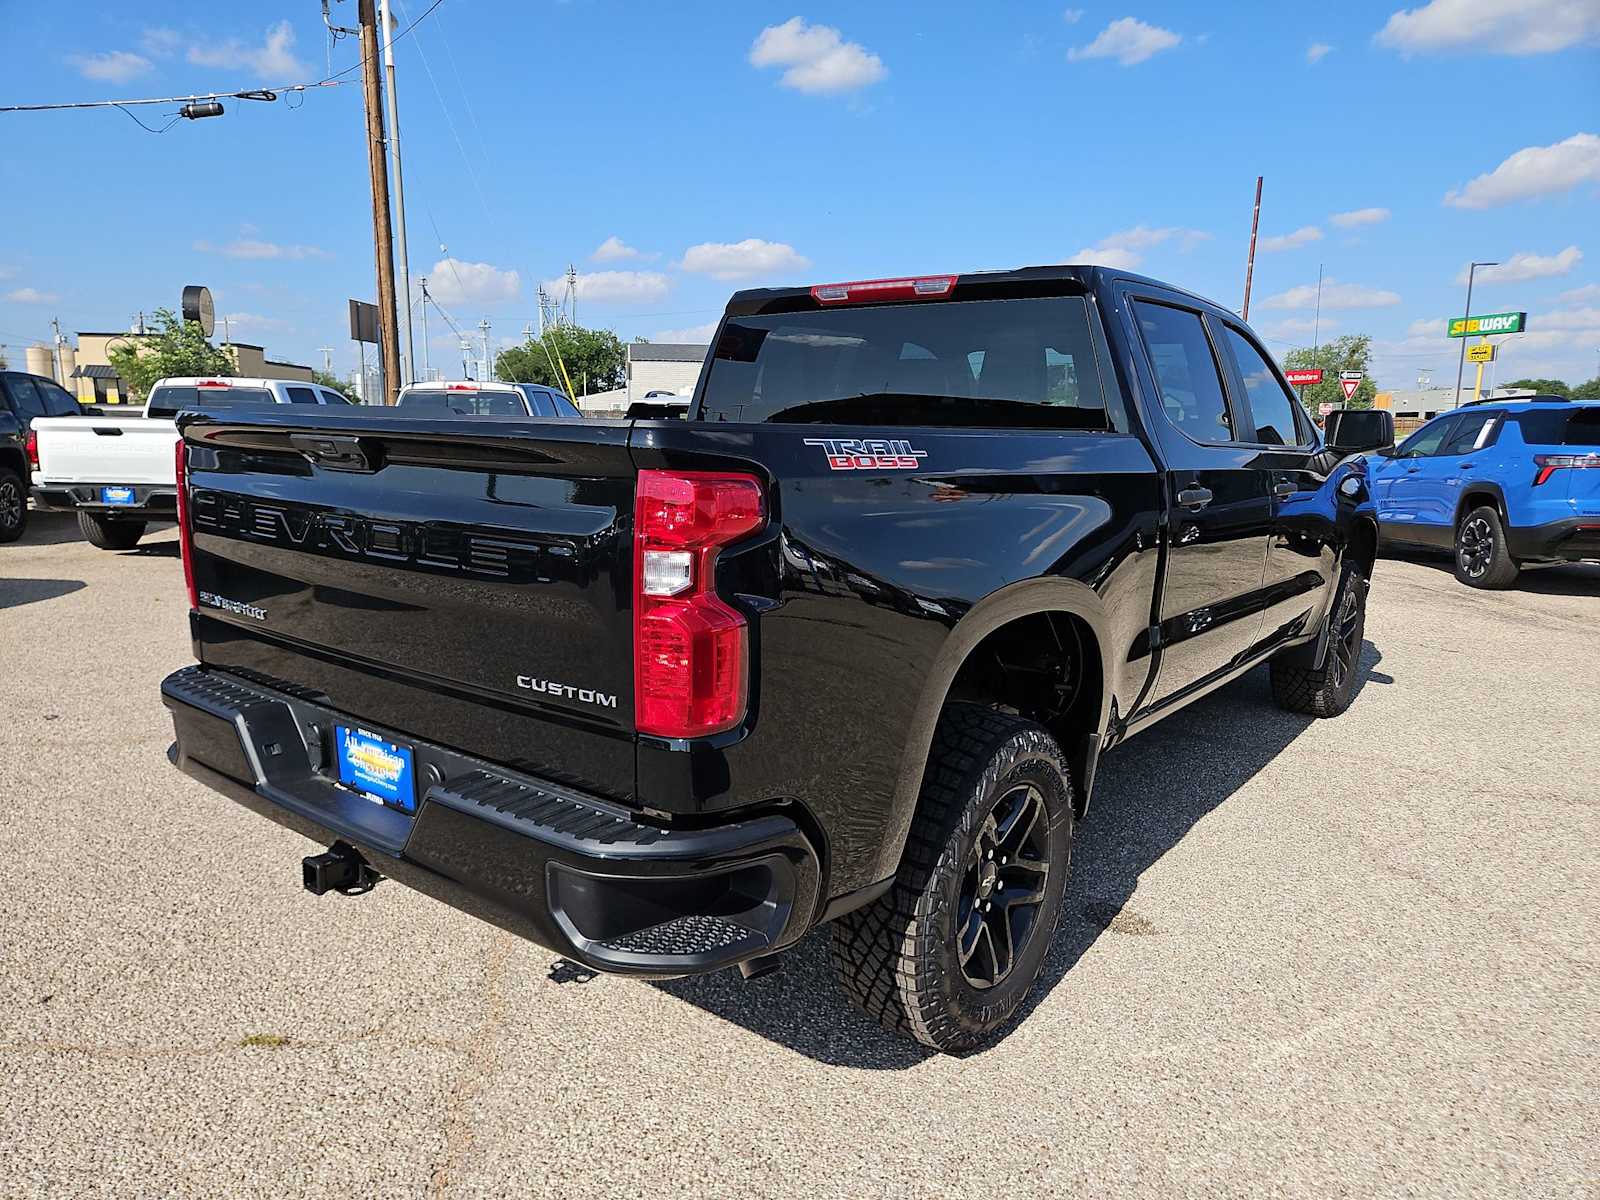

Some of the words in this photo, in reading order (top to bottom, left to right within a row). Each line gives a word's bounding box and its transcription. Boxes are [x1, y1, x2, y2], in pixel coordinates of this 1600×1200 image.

[1450, 315, 1518, 335] SUBWAY
[803, 438, 928, 457] TRAIL
[827, 455, 920, 471] BOSS
[194, 491, 576, 583] CHEVROLET
[516, 675, 617, 708] CUSTOM
